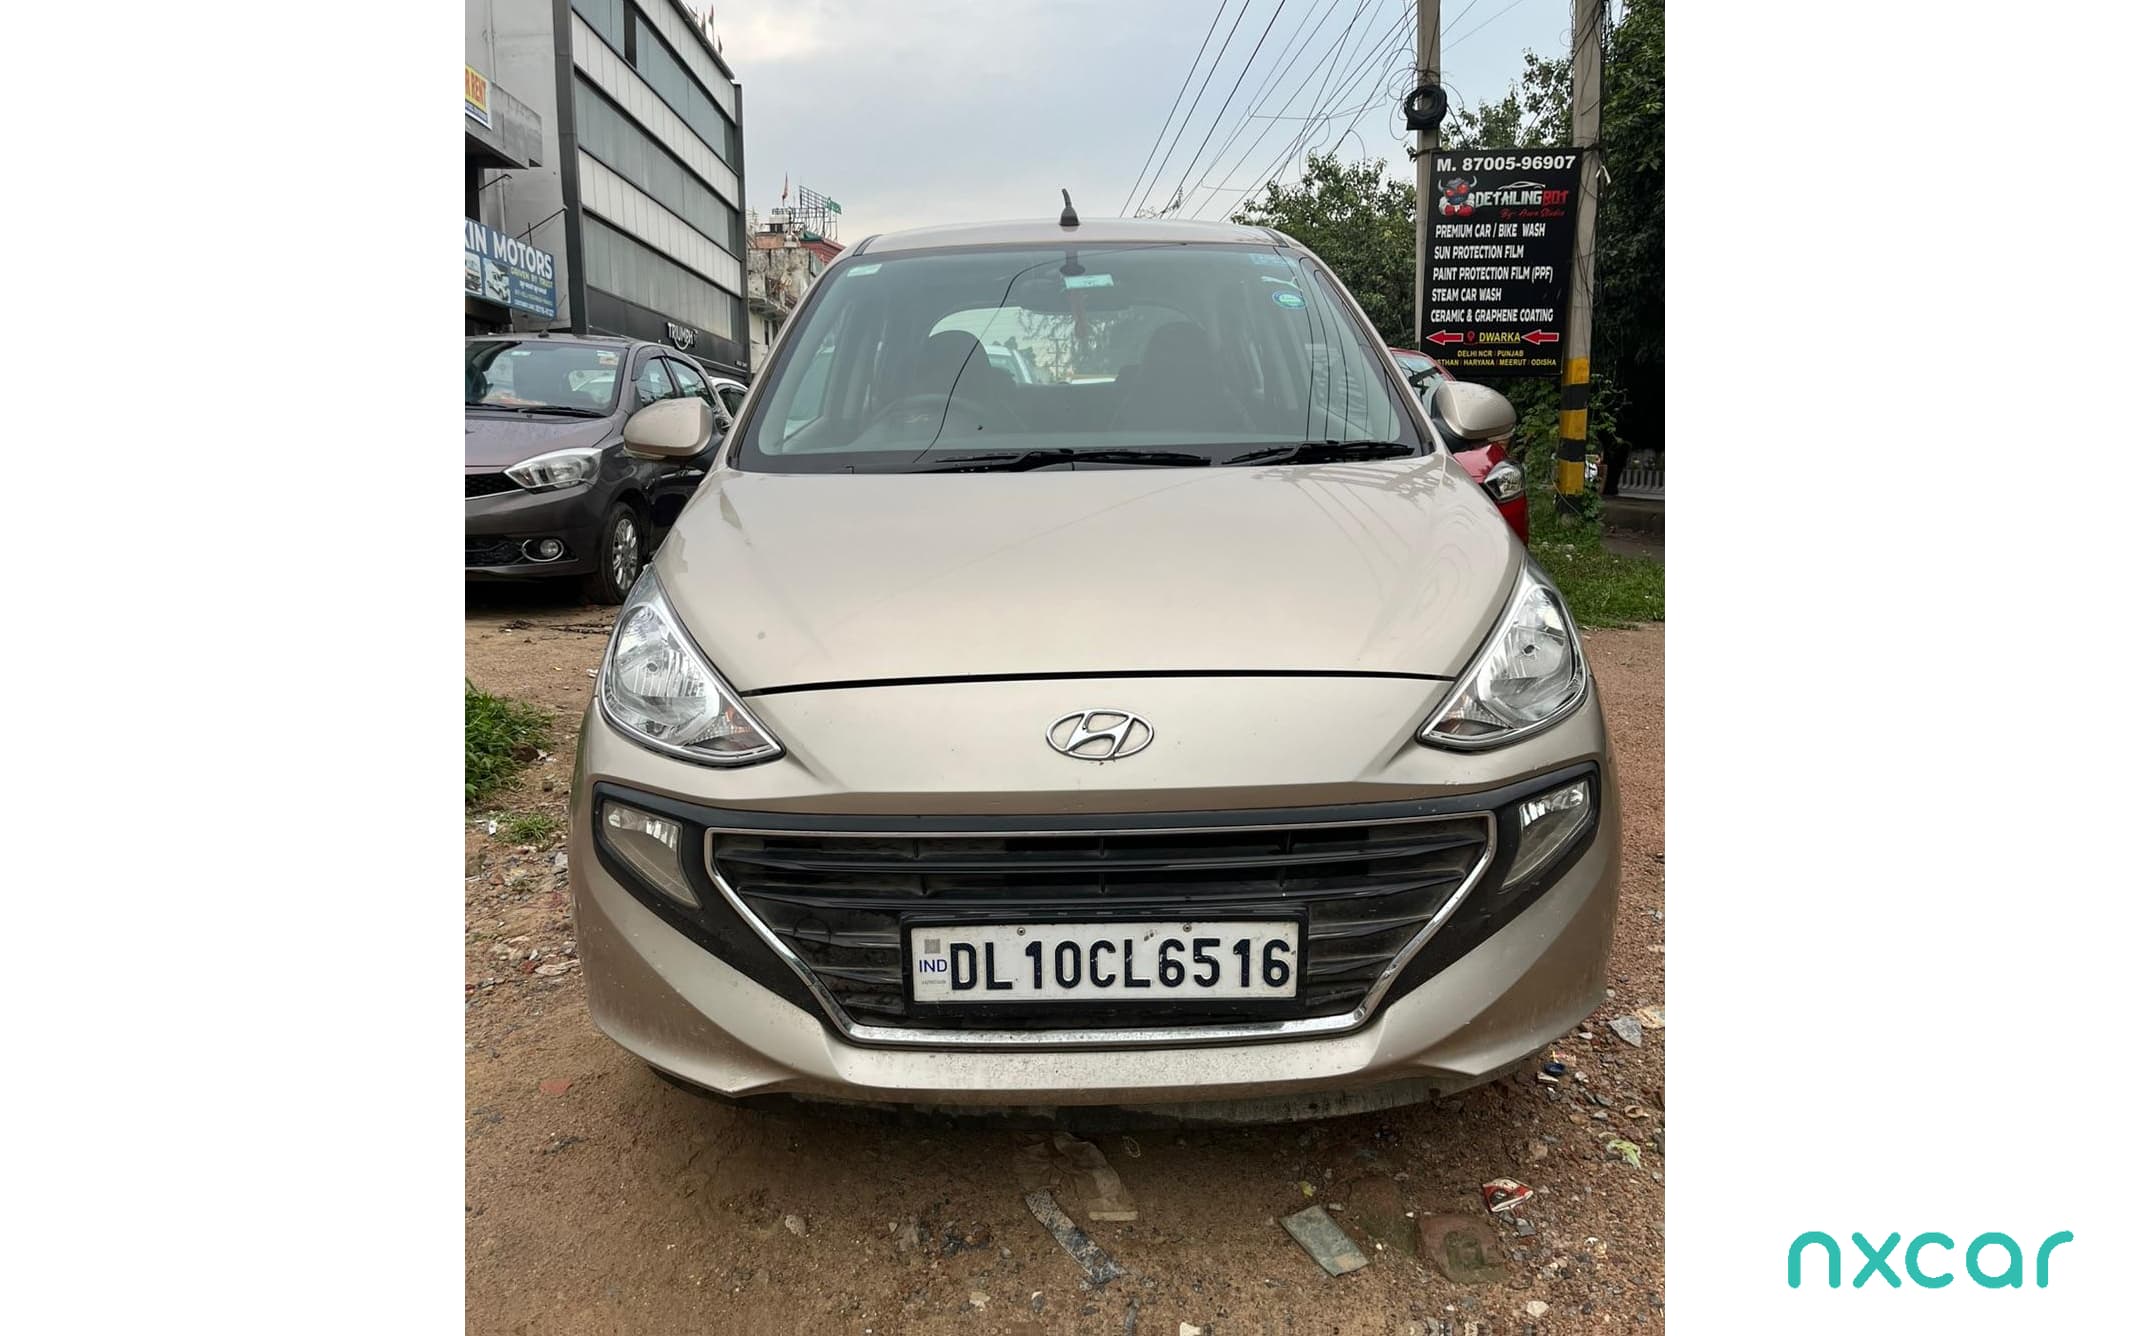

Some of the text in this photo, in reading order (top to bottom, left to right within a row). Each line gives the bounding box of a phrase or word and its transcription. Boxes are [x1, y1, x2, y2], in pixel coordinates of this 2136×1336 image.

[1437, 156, 1576, 172] M. 87005-96907
[1435, 224, 1473, 238] PREMIUM
[1474, 223, 1491, 238] CAR
[1498, 223, 1518, 237] BIKE
[1522, 223, 1546, 237] WASH
[493, 230, 553, 280] MOTORS
[1434, 244, 1524, 260] SUN PROTECTION FILM
[1433, 266, 1554, 284] PAINT PROTECTION FILM (PPF)
[1432, 288, 1502, 302] STEAM CAR WASH
[1430, 308, 1554, 322] CERAMIC & GRAPHENE COATING
[1479, 331, 1521, 342] DWARKA
[1497, 349, 1525, 357] PUNJAB
[919, 938, 1291, 991] IND DL10CL6516
